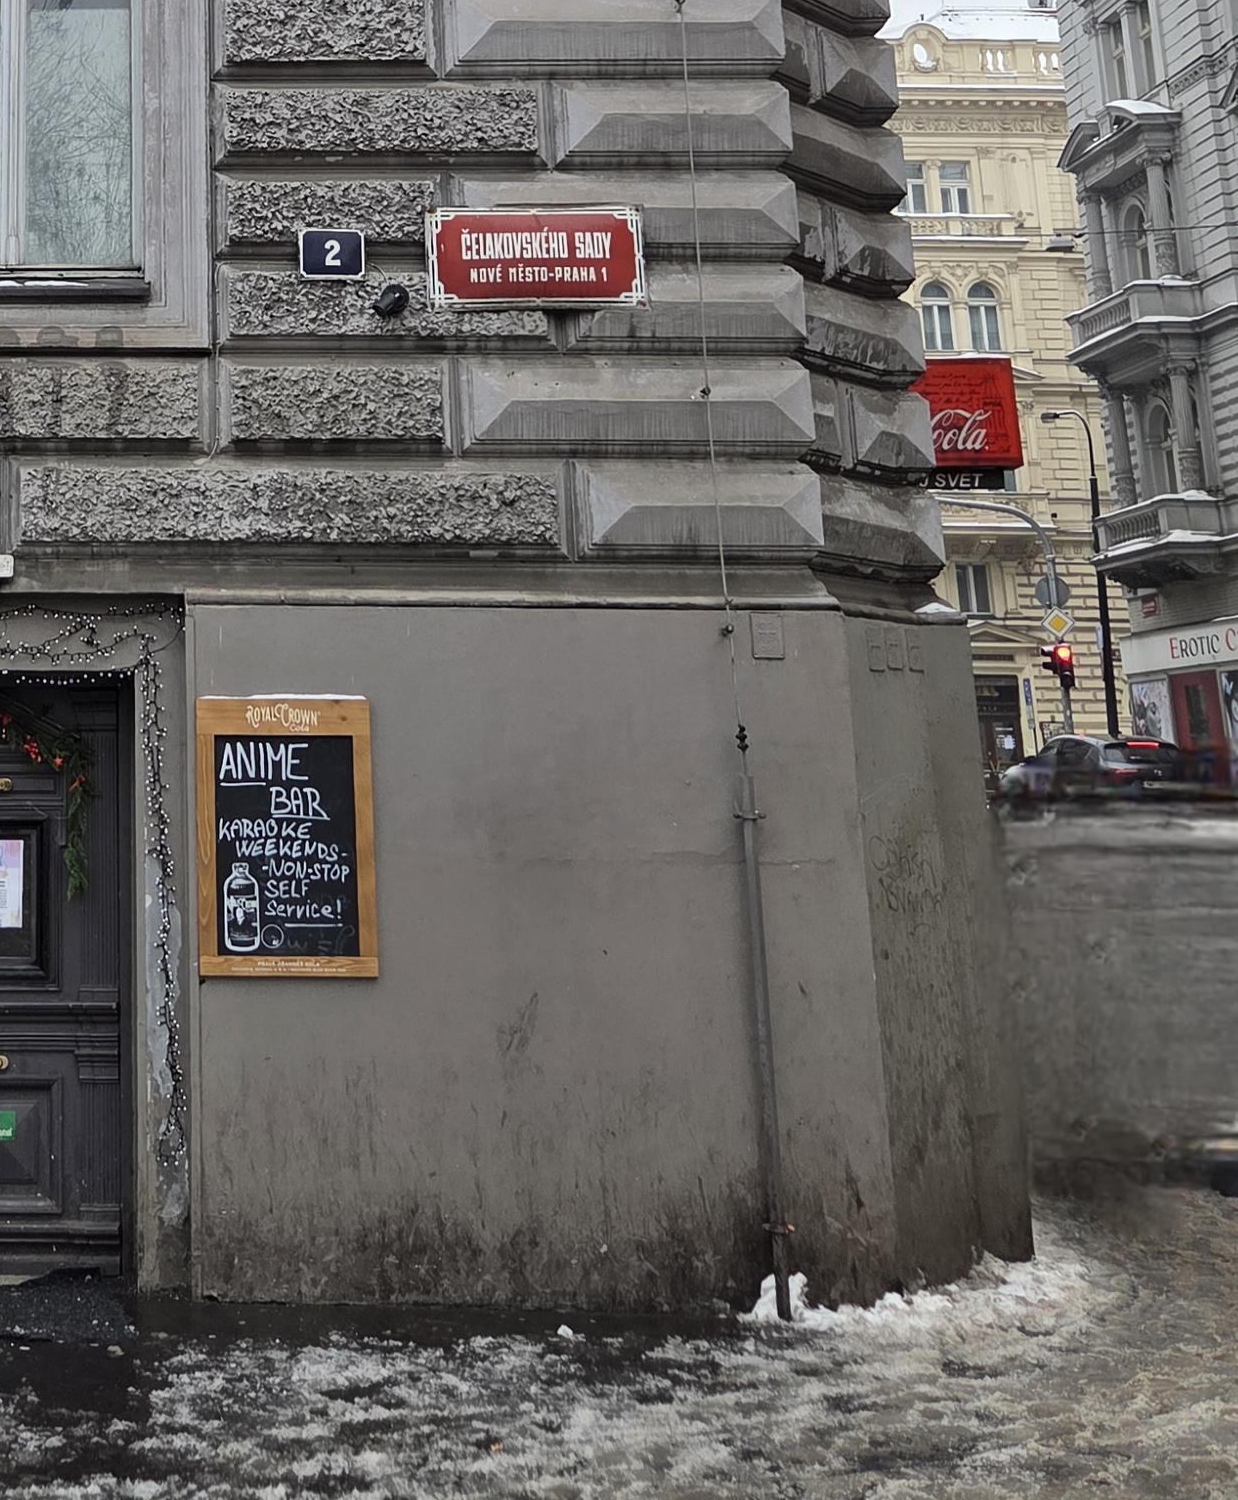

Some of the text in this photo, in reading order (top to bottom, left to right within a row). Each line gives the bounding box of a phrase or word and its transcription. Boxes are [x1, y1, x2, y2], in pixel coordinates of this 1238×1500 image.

[323, 239, 341, 267] 2
[461, 228, 611, 260] ČELAKOVSKÉHO SADY
[470, 263, 608, 283] NOVÉ MĚSTO-PRAHA 1
[934, 473, 984, 488] SVET
[1169, 634, 1220, 660] EROTIC
[245, 703, 318, 728] ROYAL CROWN
[289, 723, 310, 732] Cola
[219, 741, 309, 781] ANIME
[270, 786, 328, 818] BAR
[218, 818, 312, 842] KARAOKE
[264, 879, 310, 899] SELF
